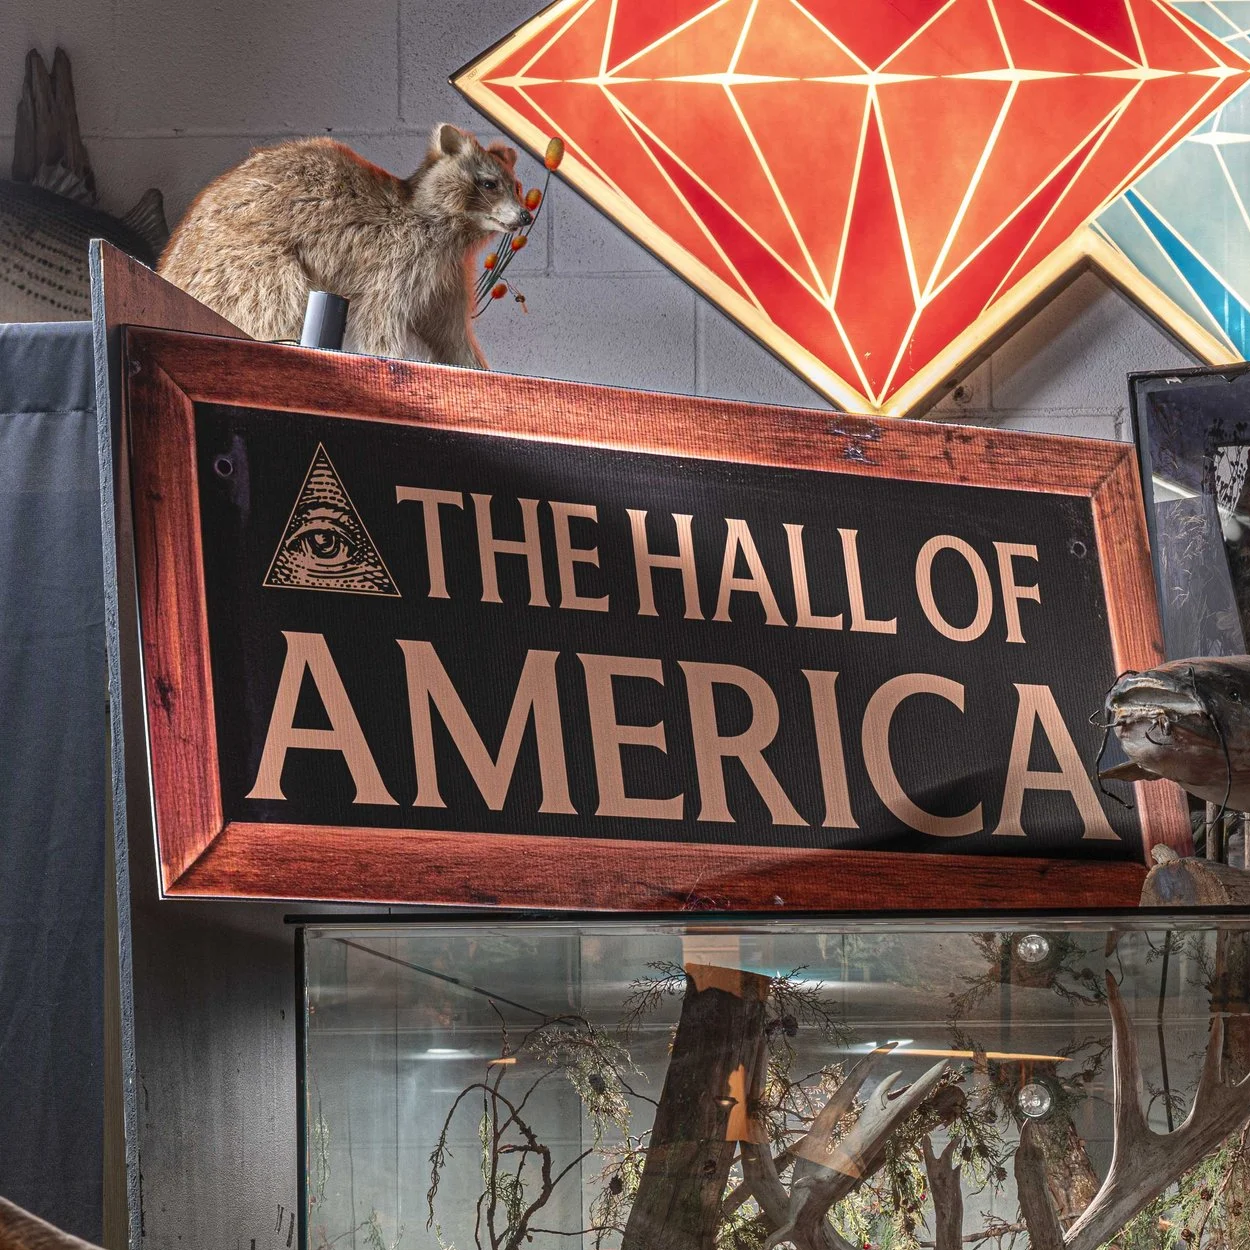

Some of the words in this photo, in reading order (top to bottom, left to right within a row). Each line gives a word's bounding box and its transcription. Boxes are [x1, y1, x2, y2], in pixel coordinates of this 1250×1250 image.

[395, 485, 610, 613] THE
[625, 508, 898, 635] HALL
[915, 534, 1042, 645] OF
[244, 630, 1122, 841] AMERICA
